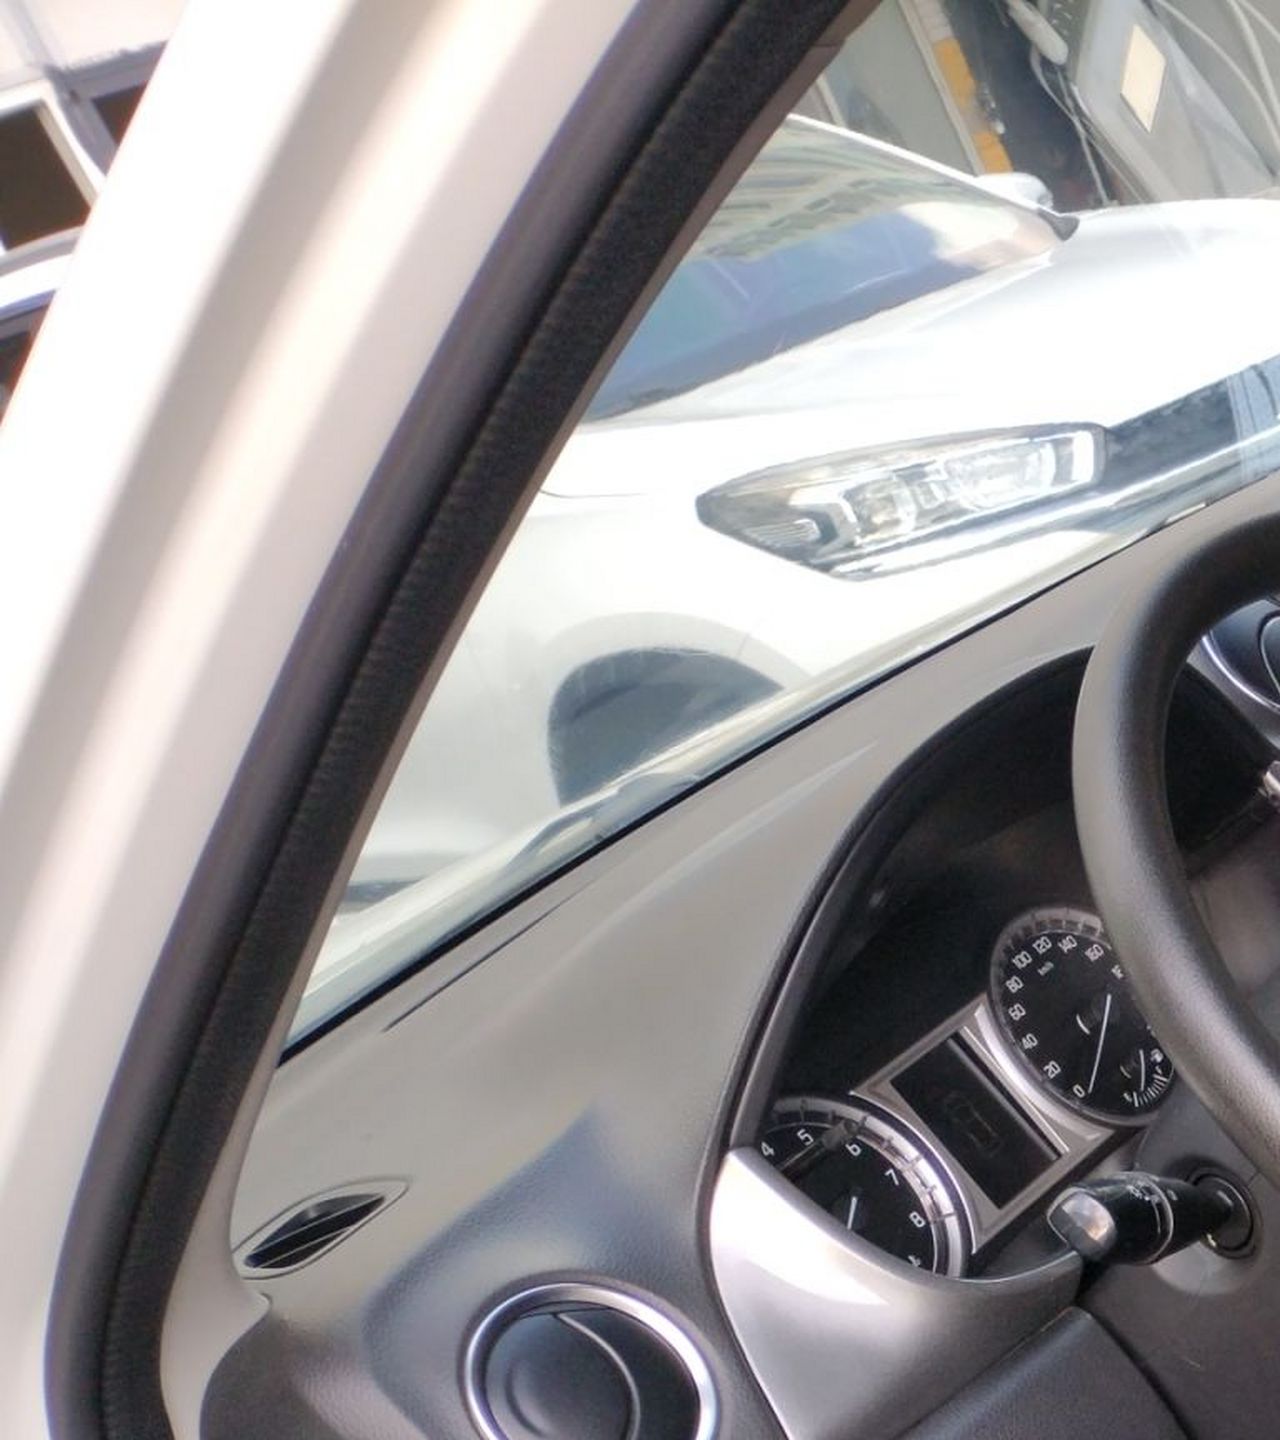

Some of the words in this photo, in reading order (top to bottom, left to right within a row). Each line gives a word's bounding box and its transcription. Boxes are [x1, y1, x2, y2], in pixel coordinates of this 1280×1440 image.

[1031, 935, 1053, 955] 120
[1057, 934, 1079, 954] 140
[1011, 950, 1033, 970] 100
[1005, 975, 1024, 994] 80
[1008, 1003, 1027, 1021] 60
[1021, 1032, 1039, 1050] 40
[1043, 1060, 1062, 1080] 20
[1072, 1083, 1086, 1098] 0
[796, 1128, 815, 1146] 5
[760, 1141, 775, 1157] 4
[845, 1142, 862, 1157] 6
[884, 1168, 900, 1187] 7
[909, 1210, 927, 1229] 8
